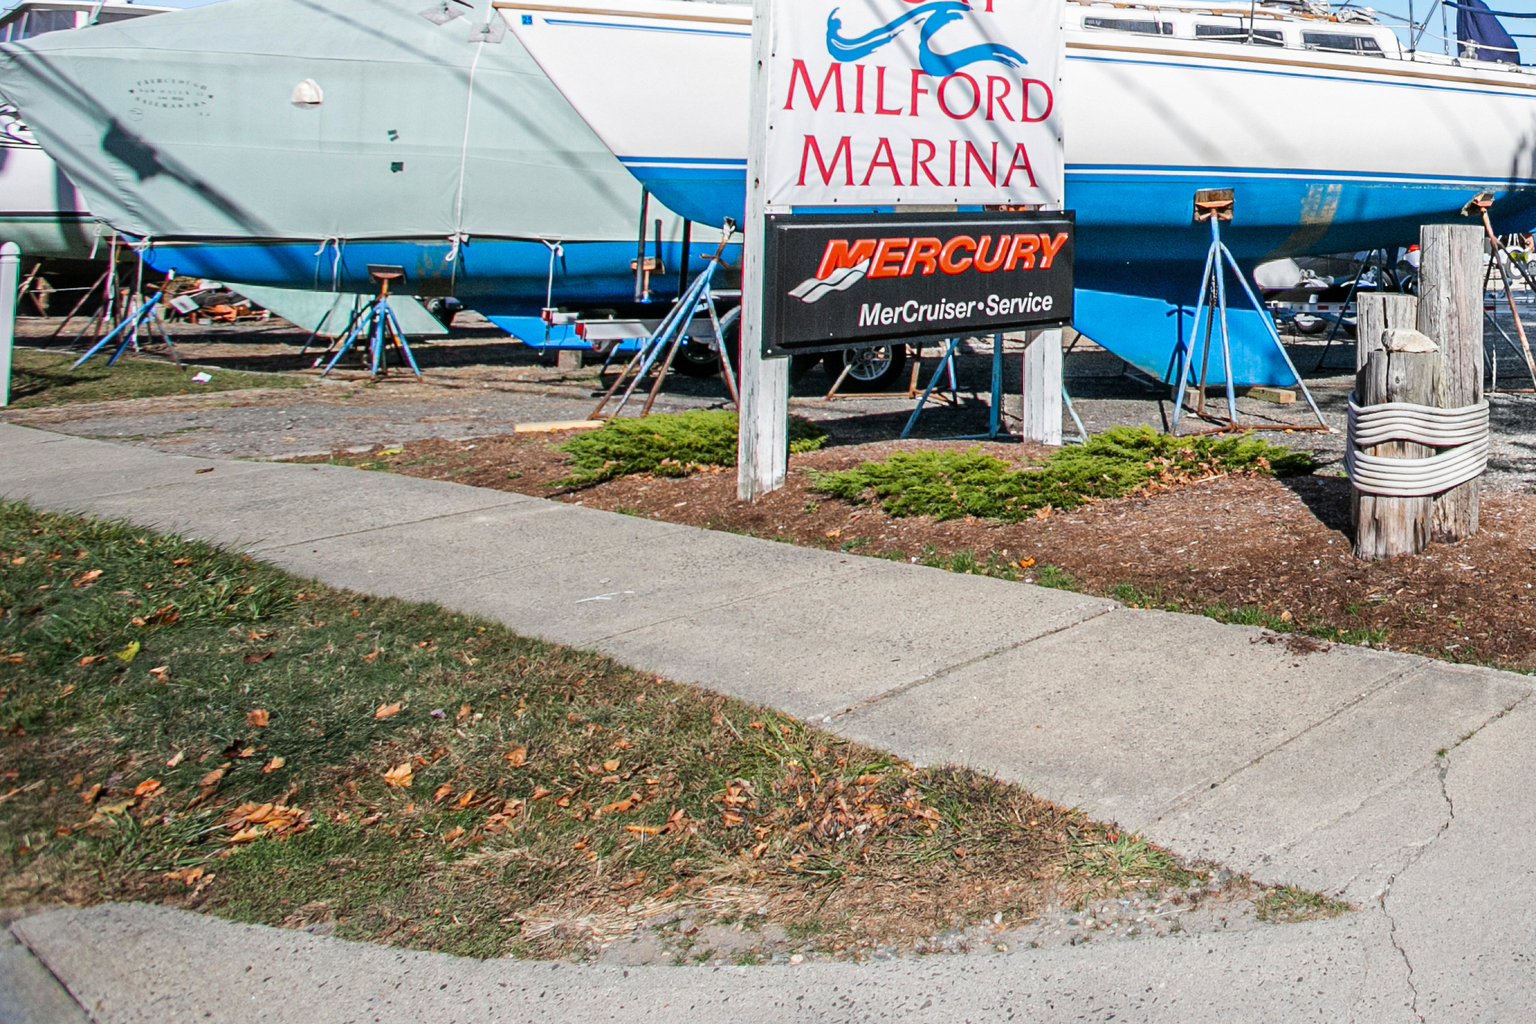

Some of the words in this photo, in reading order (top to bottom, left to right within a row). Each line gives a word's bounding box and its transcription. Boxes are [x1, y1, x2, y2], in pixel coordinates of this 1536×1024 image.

[783, 58, 1054, 123] MILFORD
[795, 134, 1039, 188] MARINA
[815, 232, 1069, 280] MERCURY
